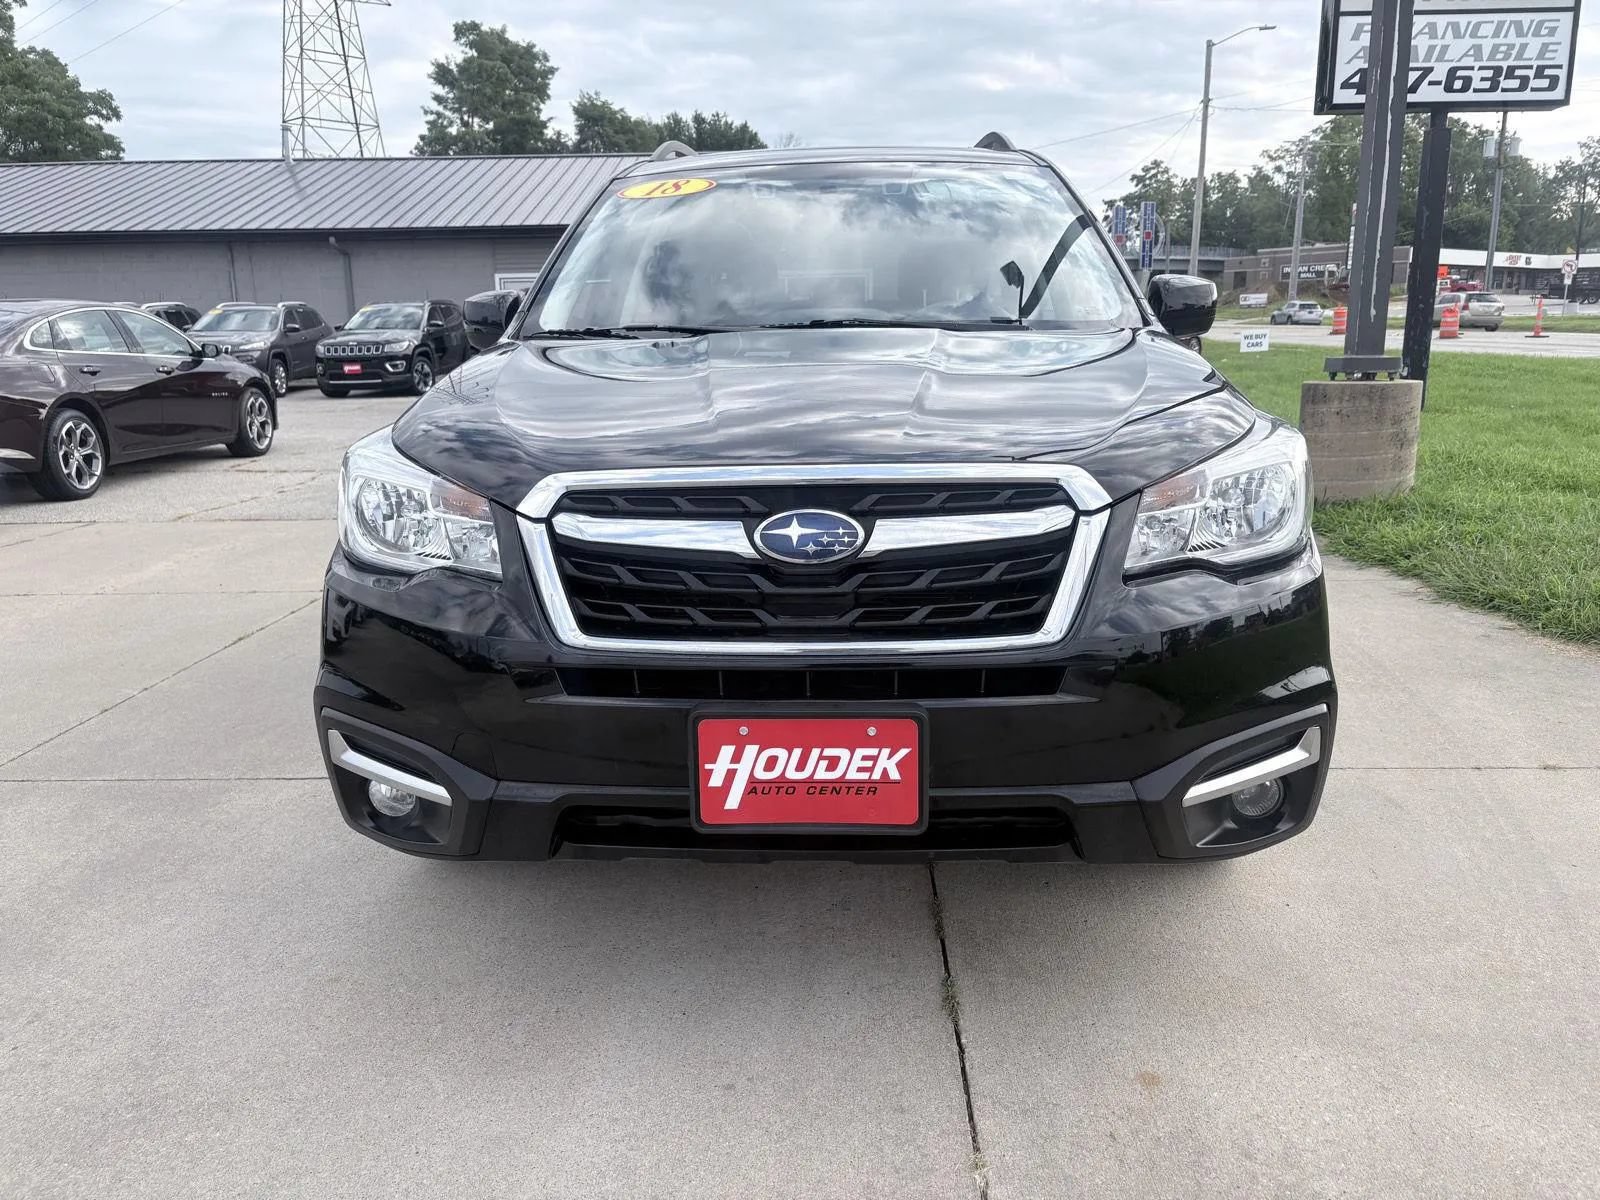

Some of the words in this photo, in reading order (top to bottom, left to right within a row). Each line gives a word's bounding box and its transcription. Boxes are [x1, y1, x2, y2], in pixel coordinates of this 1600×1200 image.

[1350, 19, 1561, 41] FANCING
[1344, 42, 1562, 64] AILABLE
[1340, 64, 1563, 95] 47-6355
[1283, 264, 1308, 273] INAN
[704, 744, 912, 810] HOUDEK
[747, 785, 797, 796] AUTO
[806, 785, 878, 796] CENTER
